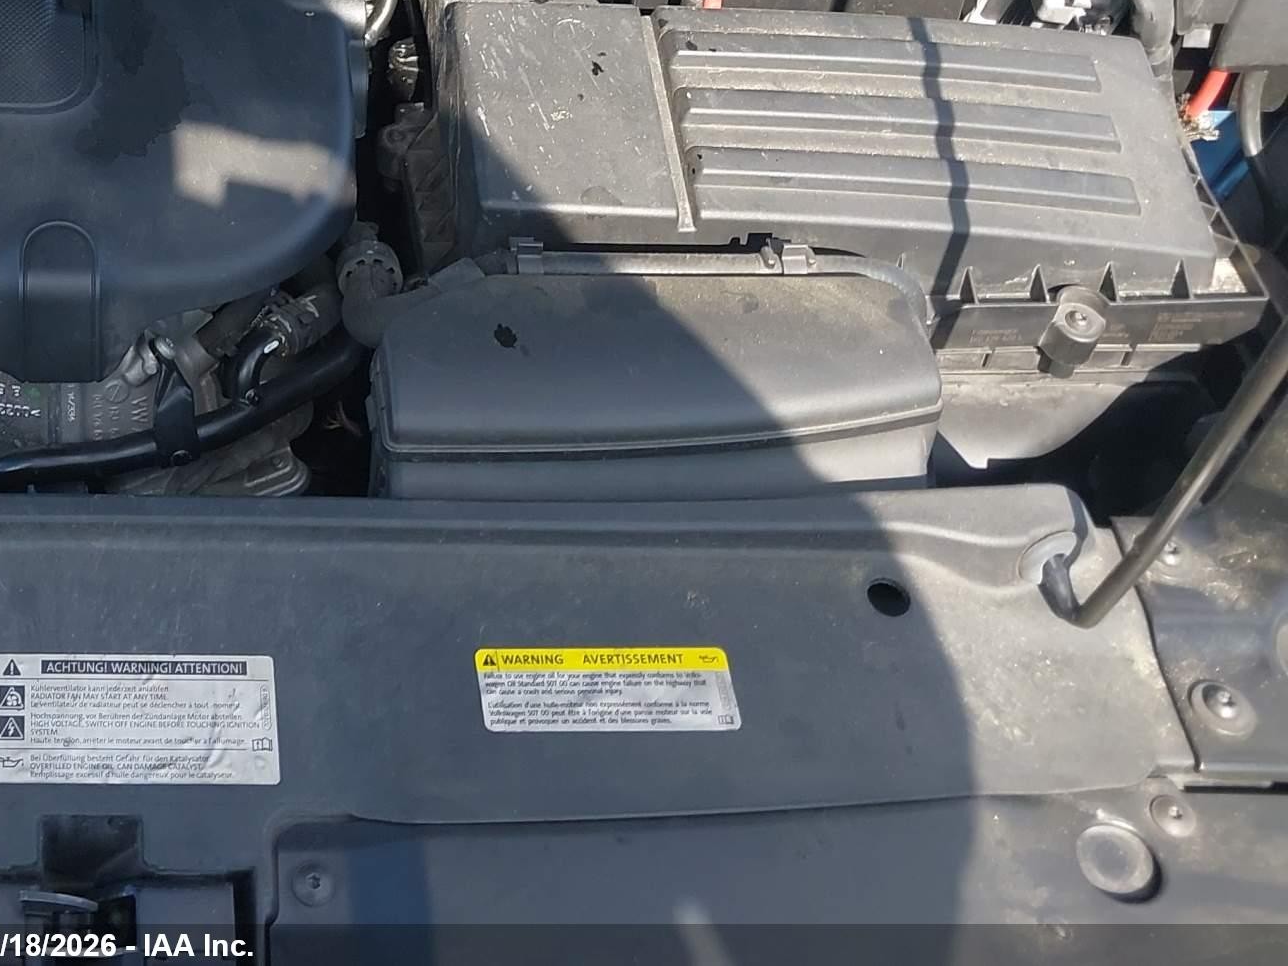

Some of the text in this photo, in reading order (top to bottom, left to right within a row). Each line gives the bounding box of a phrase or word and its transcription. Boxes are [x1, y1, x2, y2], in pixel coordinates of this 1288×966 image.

[501, 654, 684, 665] WARNING AVERTISSEMENT
[47, 662, 242, 674] ACHTUNG! WARNING! ATTENTION!
[88, 684, 105, 692] kann
[122, 702, 138, 710] peut
[187, 721, 225, 729] TOUCHING
[115, 754, 140, 762] Gefahr
[134, 763, 166, 771] DAMAGE
